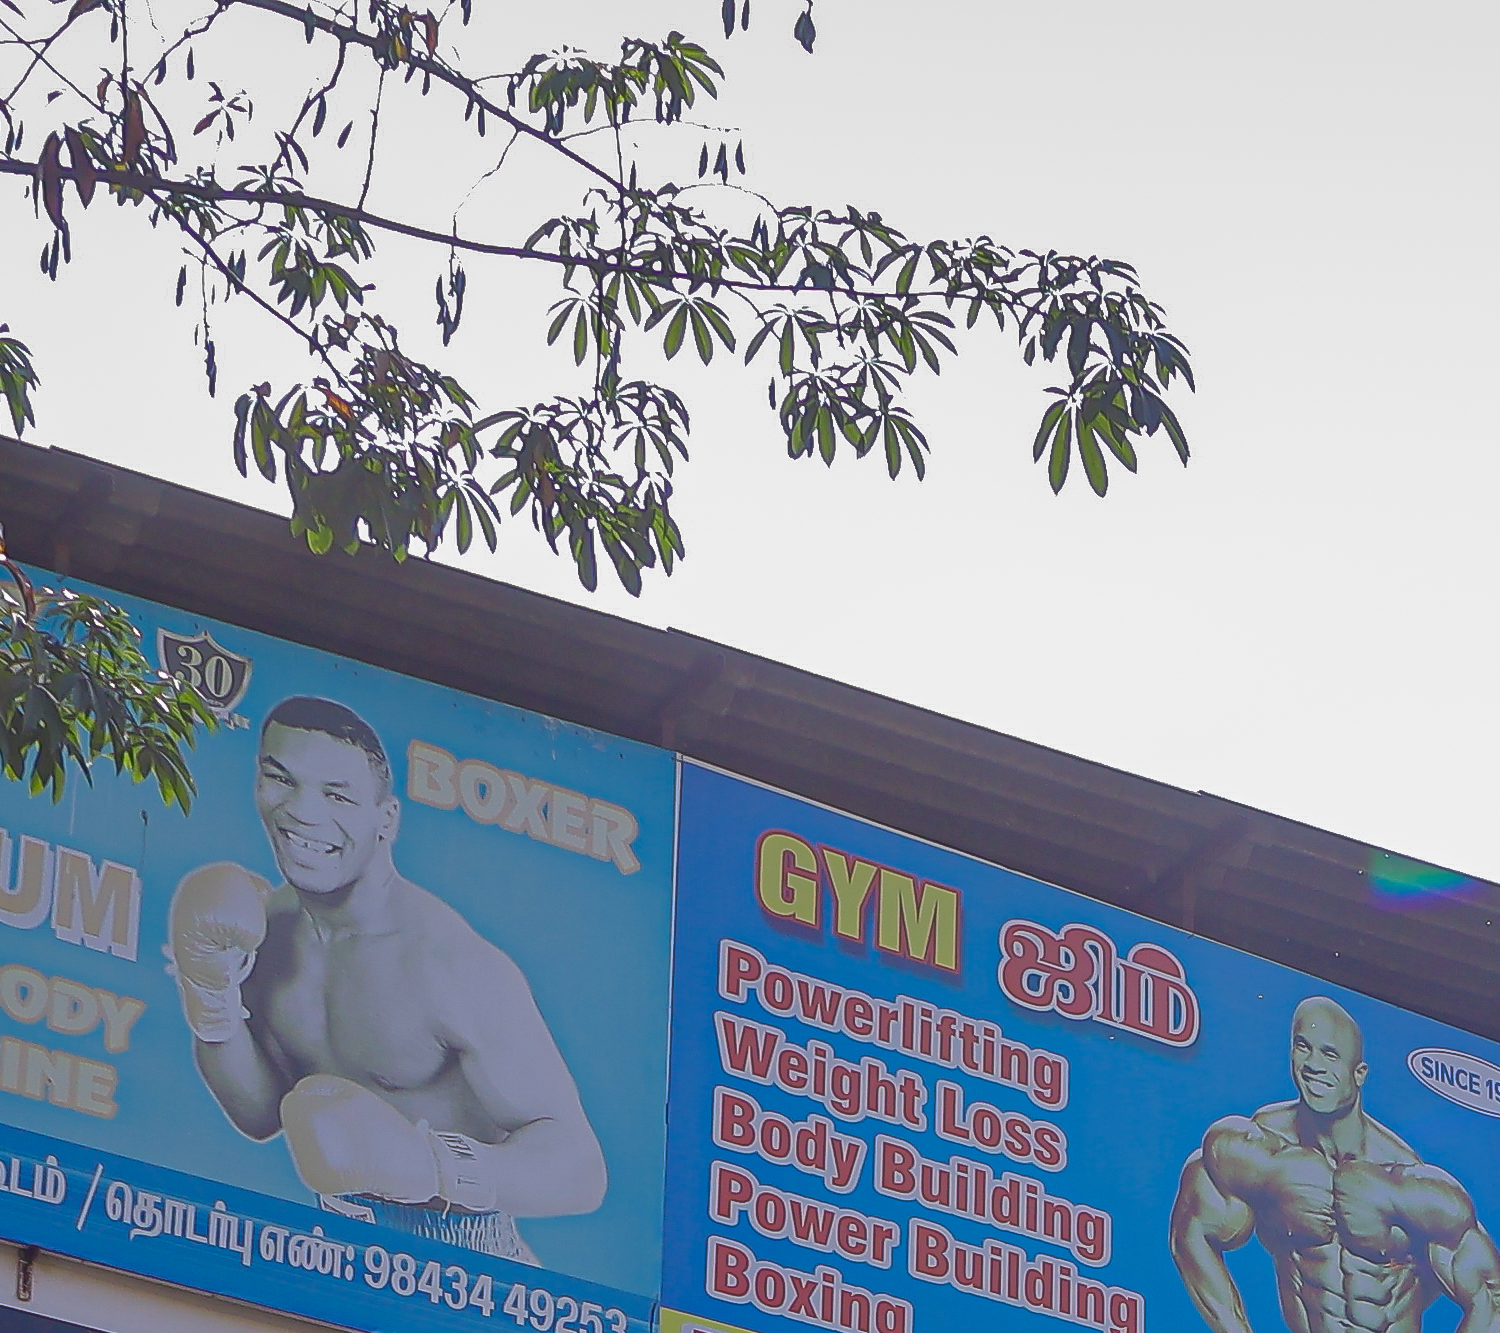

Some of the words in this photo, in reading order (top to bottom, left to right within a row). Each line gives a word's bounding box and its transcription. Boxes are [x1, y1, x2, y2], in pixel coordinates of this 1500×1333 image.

[406, 742, 640, 876] BOXER
[753, 828, 963, 976] GYM
[996, 917, 1202, 1050] ஜிம்
[714, 1013, 924, 1126] Weight
[941, 1076, 1069, 1171] Loss
[719, 938, 1069, 1111] Powerlifting
[1418, 1050, 1481, 1098] SINCE
[709, 1167, 898, 1271] Power
[712, 1085, 862, 1197] Body
[873, 1122, 1112, 1266] Building
[363, 1244, 495, 1318] 98434
